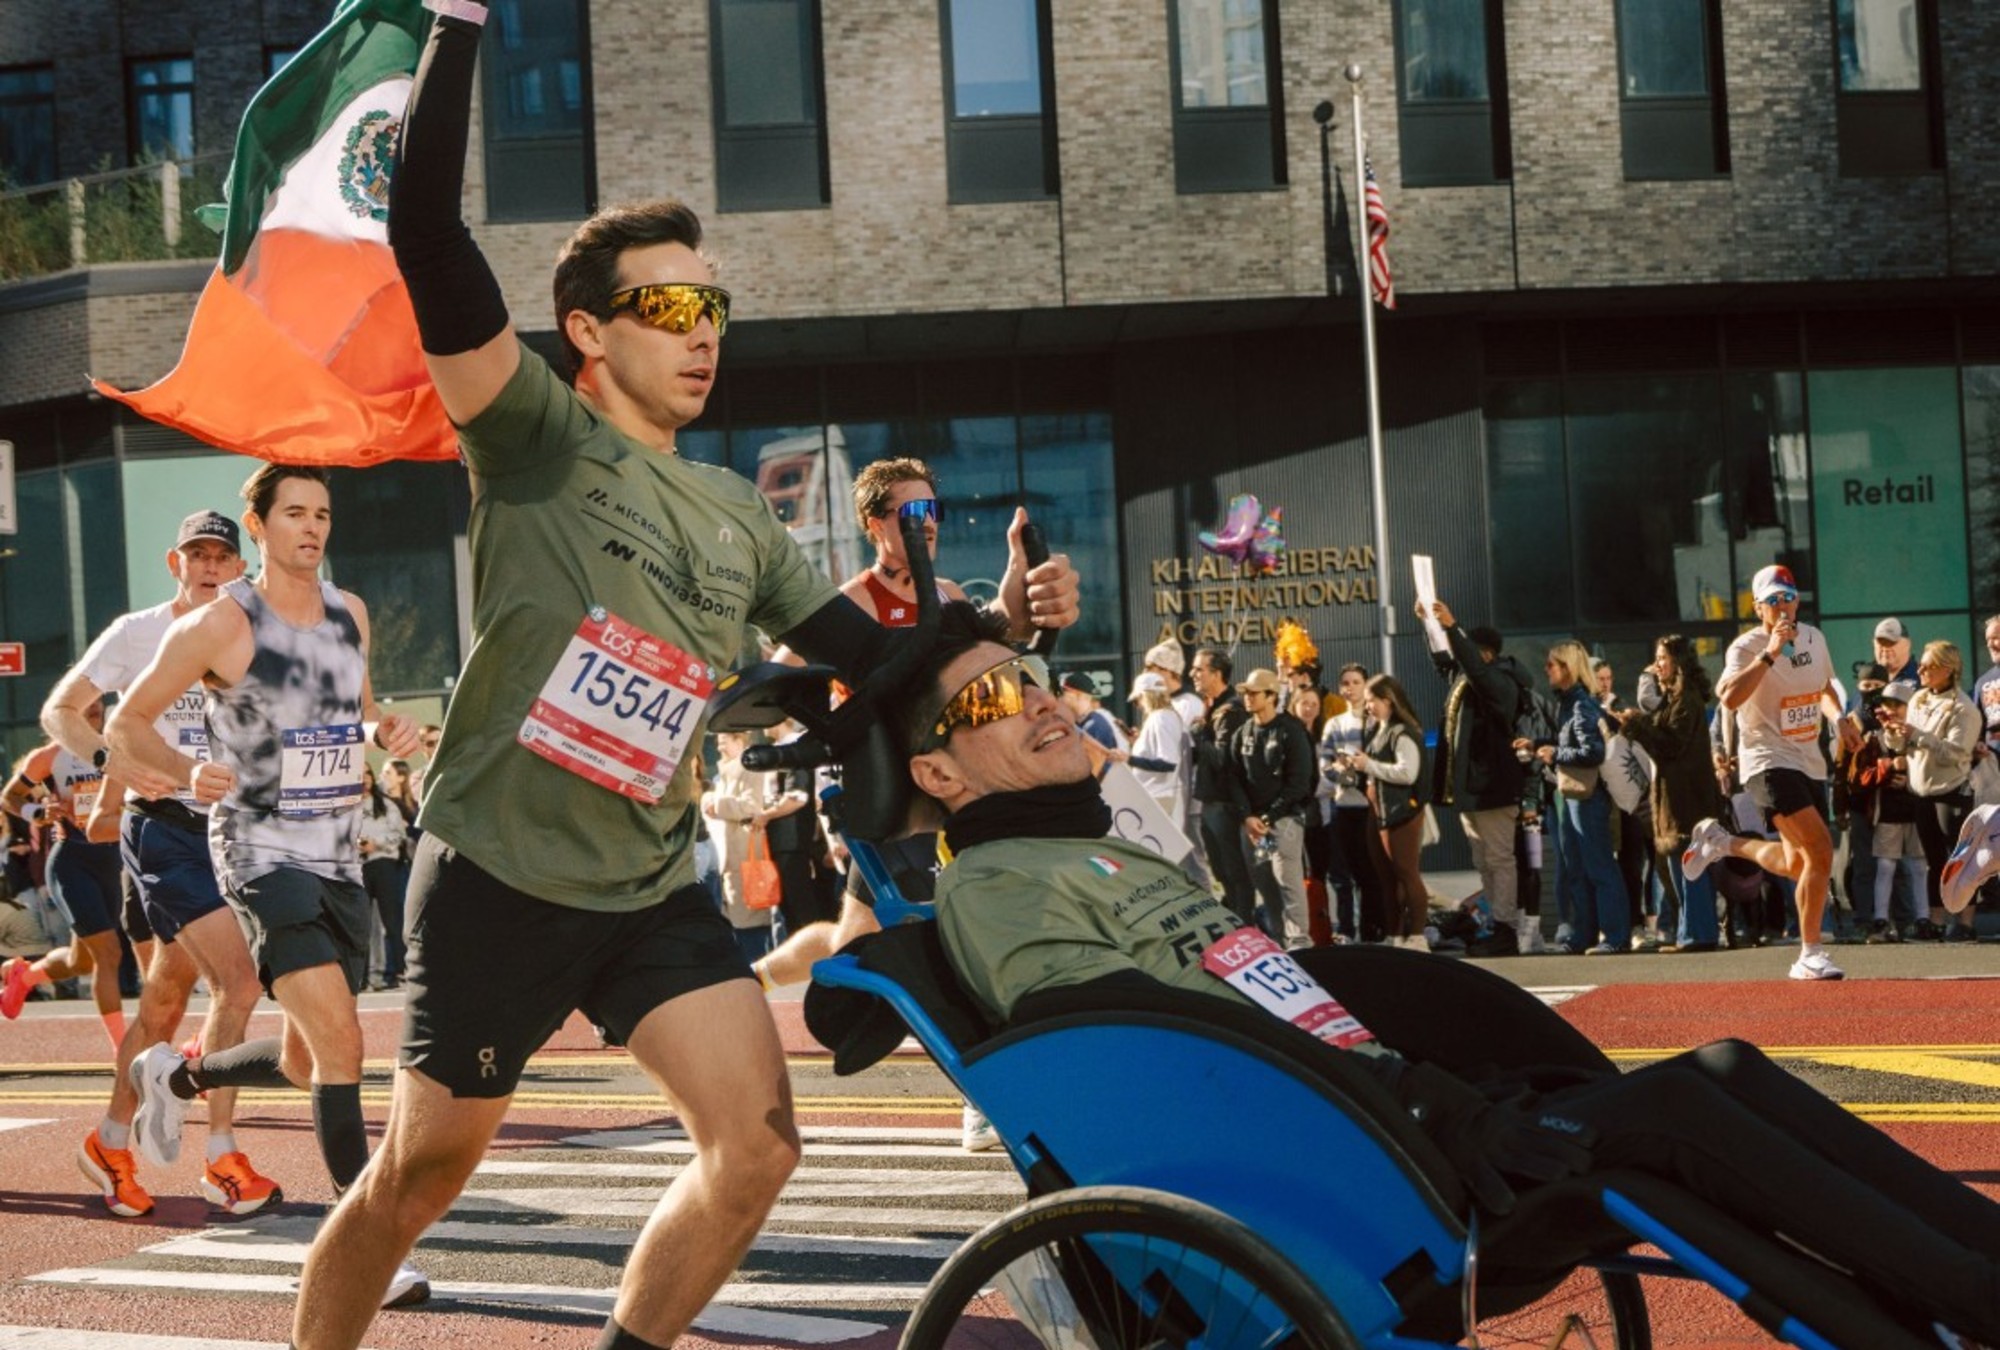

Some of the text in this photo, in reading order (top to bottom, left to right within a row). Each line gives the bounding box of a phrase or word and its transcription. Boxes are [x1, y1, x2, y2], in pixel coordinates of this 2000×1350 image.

[1843, 475, 1934, 506] Retail
[600, 622, 637, 657] tcs
[1157, 615, 1308, 644] ACADEM
[570, 651, 692, 740] 15544
[1787, 706, 1818, 724] 9344
[295, 731, 315, 745] tcs
[302, 746, 351, 778] 7174
[1213, 944, 1252, 968] tcs
